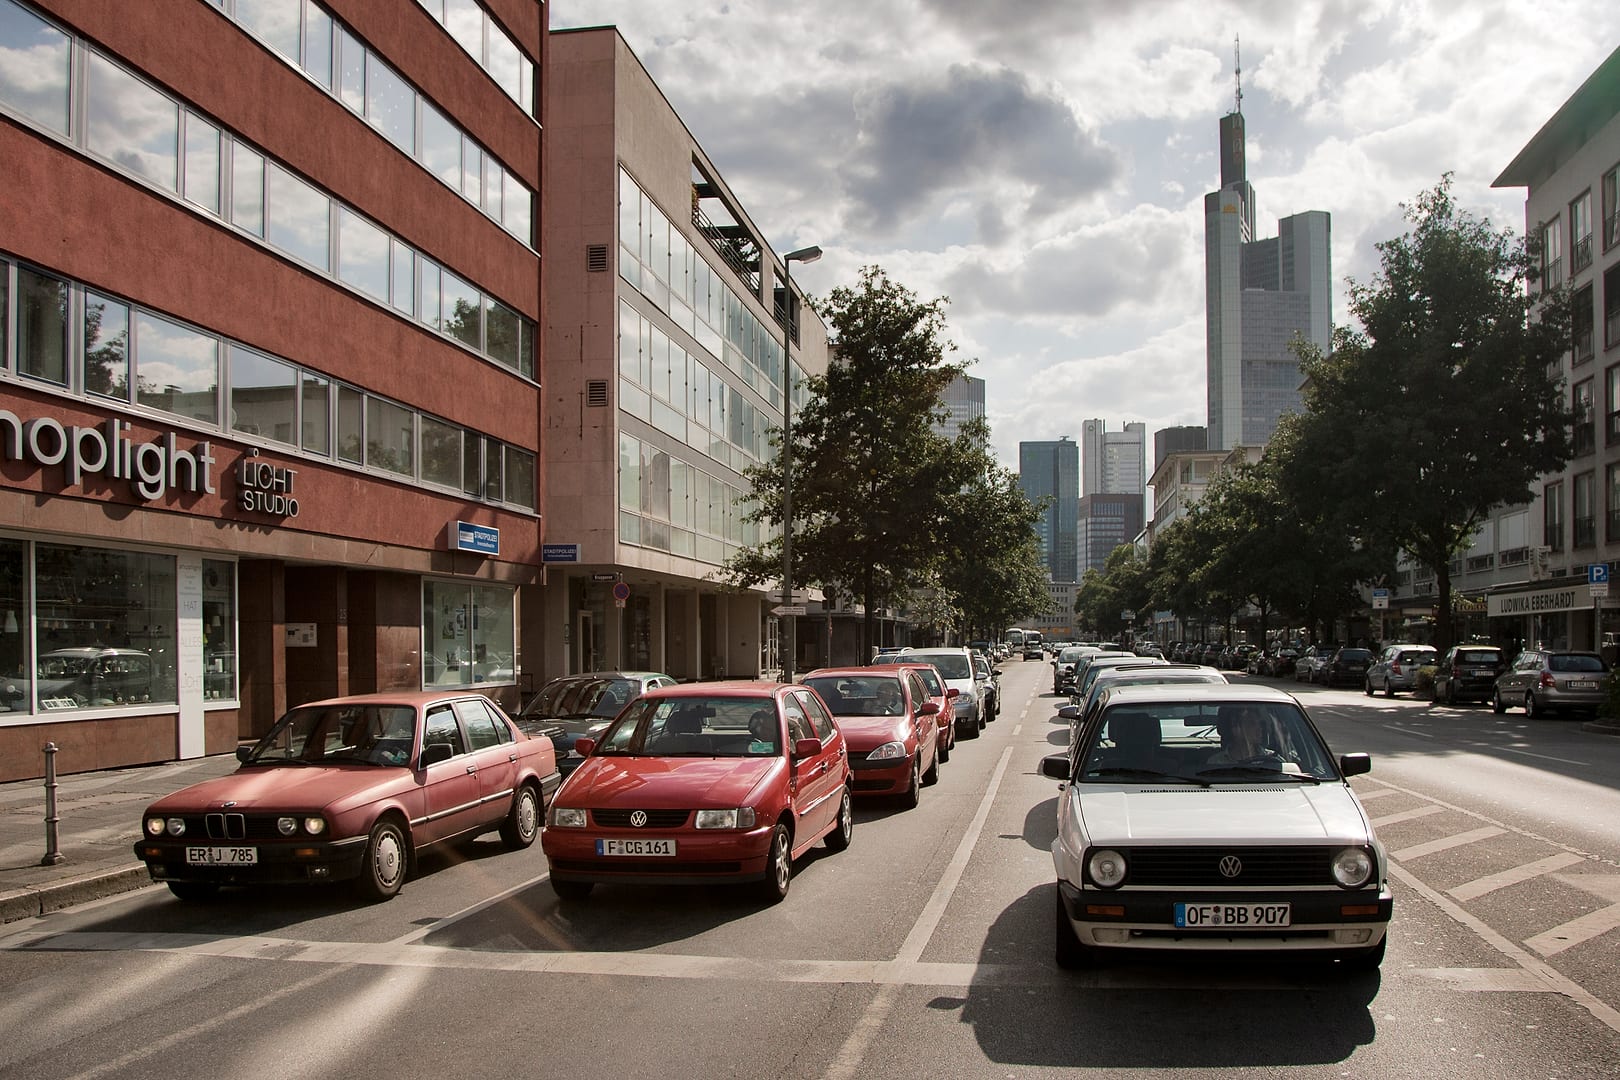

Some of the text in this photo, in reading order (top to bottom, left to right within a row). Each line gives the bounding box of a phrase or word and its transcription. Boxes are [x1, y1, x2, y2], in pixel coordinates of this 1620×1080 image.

[243, 453, 299, 495] LICHT
[243, 490, 300, 518] STUDIO
[1593, 567, 1604, 581] P
[1500, 591, 1576, 613] LUDWIKA EBERHARDT
[189, 848, 253, 861] ER J 785
[608, 841, 670, 854] F CG 161
[1187, 906, 1211, 924] OF
[1224, 906, 1249, 924] BB
[1253, 906, 1289, 924] 907
